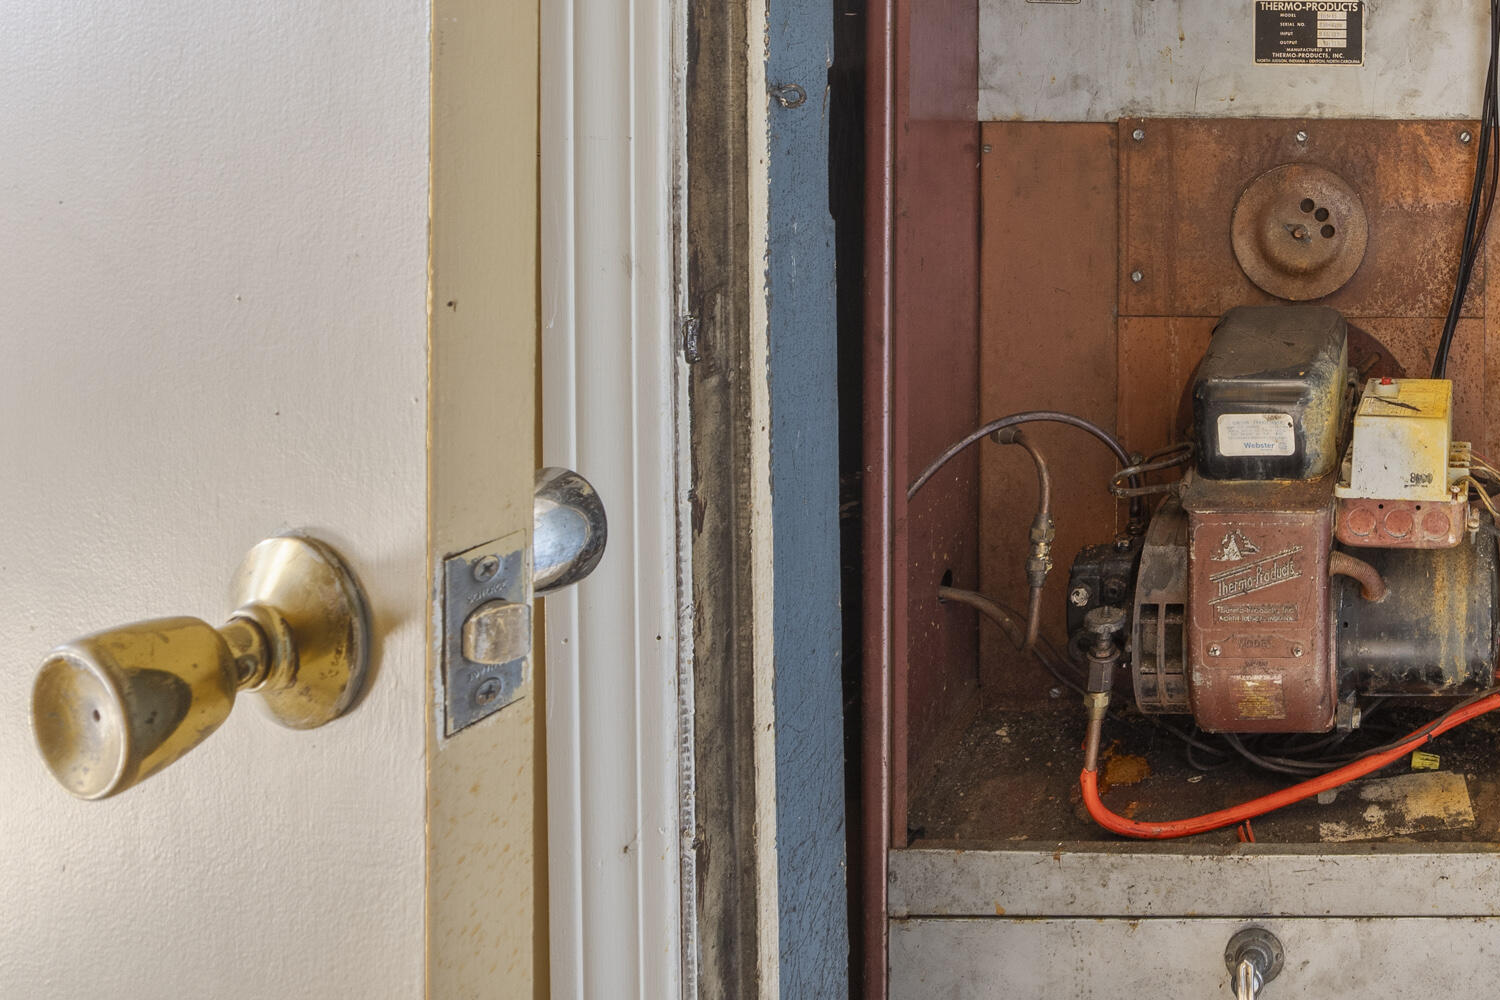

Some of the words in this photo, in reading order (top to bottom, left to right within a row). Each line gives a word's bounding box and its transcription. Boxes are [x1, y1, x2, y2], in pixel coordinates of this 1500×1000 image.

[1260, 1, 1358, 12] THERMO-PRODUCTS
[1243, 441, 1275, 449] Webster
[1213, 561, 1295, 597] Thermo-Products
